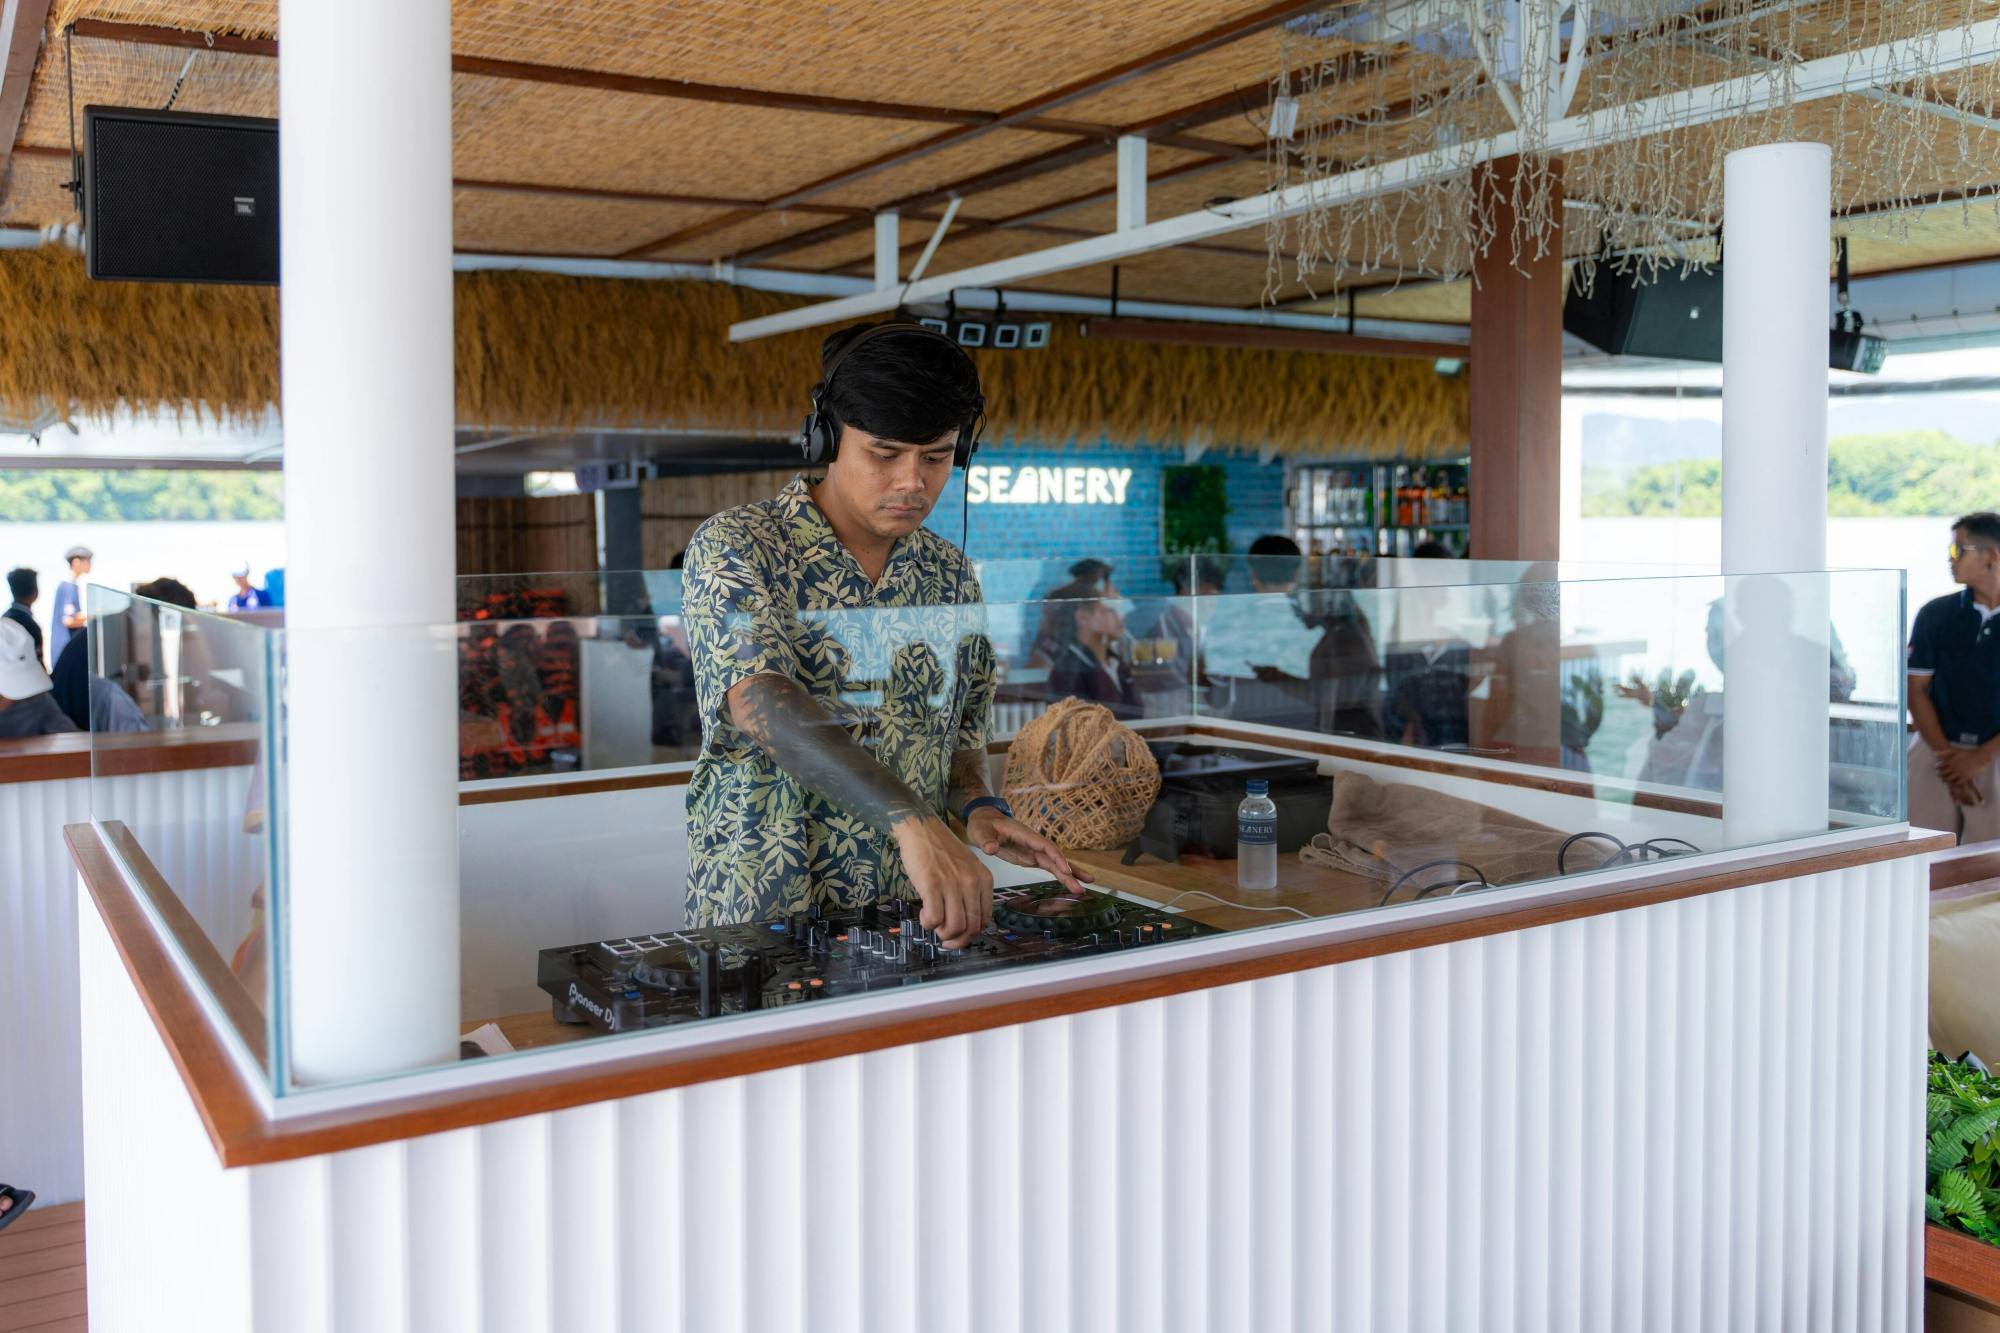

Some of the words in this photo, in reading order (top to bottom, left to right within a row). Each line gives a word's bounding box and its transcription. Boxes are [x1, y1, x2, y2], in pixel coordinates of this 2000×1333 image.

[967, 465, 1132, 504] SEANERY
[568, 983, 604, 1018] Pioneer
[604, 1008, 616, 1031] DJ
